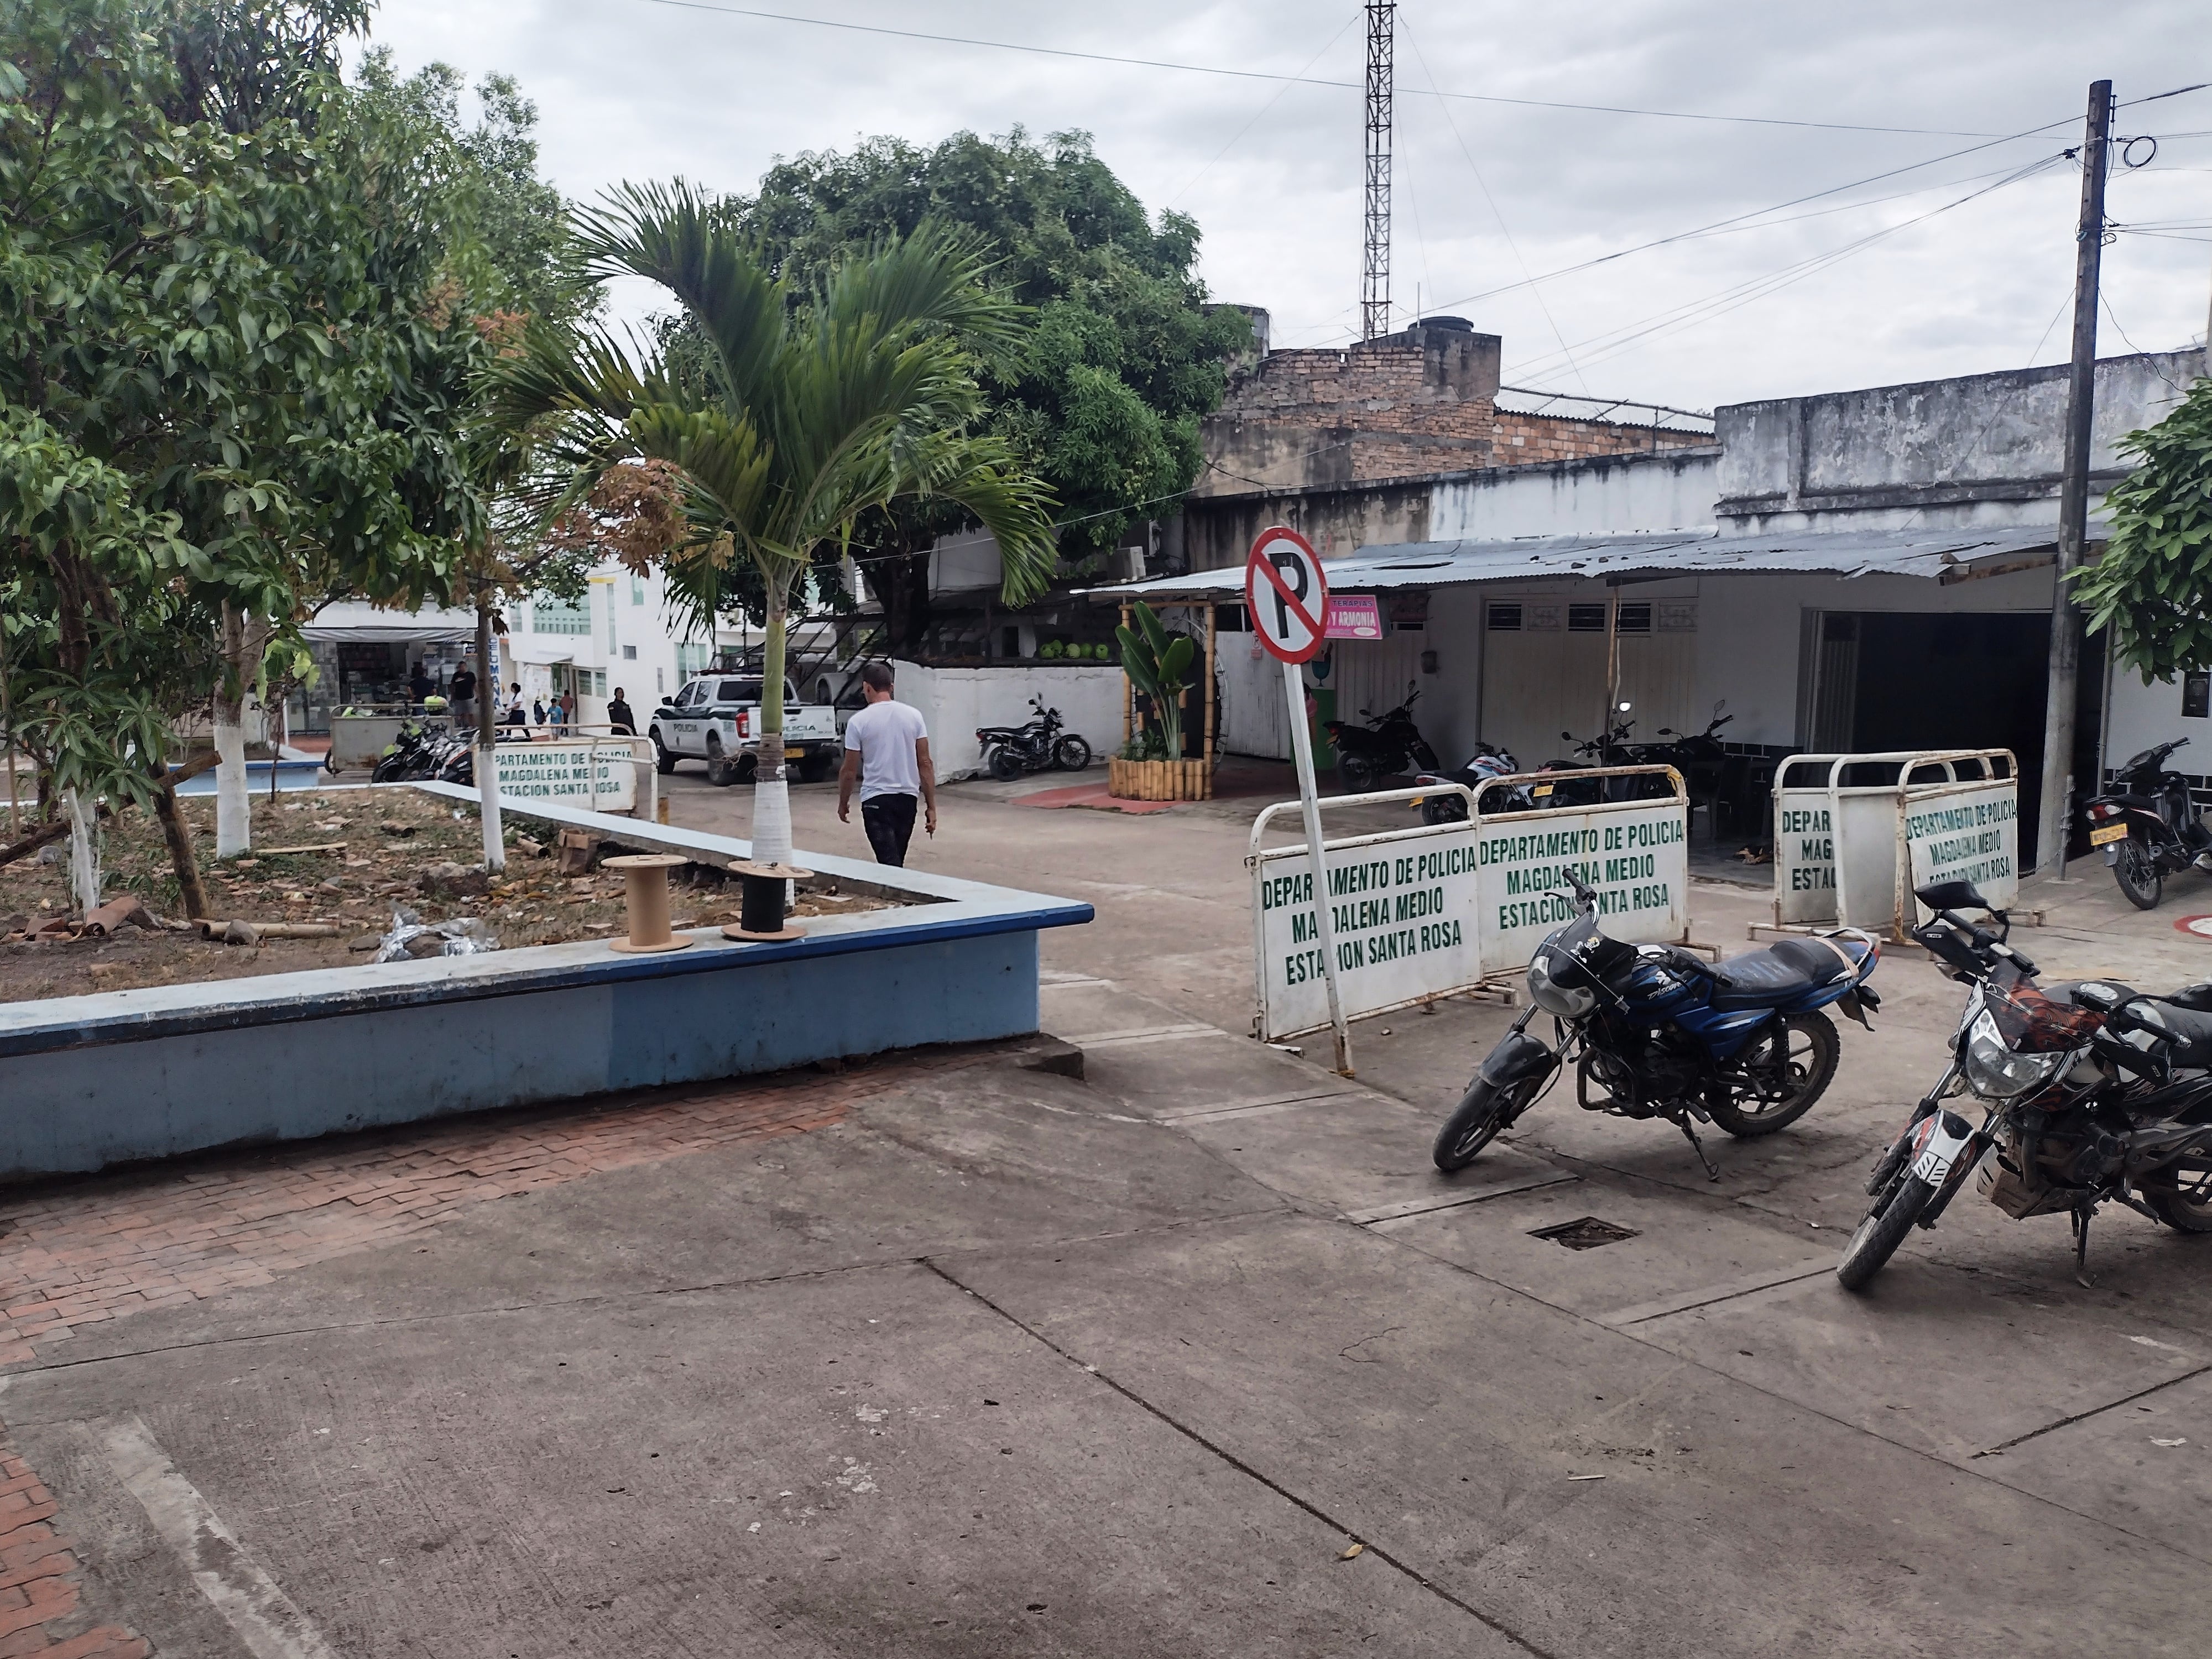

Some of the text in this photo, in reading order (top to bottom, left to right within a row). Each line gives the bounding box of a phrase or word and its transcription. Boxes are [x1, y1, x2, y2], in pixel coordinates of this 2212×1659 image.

[1331, 612, 1336, 626] Y
[1338, 612, 1376, 627] ARMONIA
[674, 723, 698, 732] POLICIA
[495, 753, 566, 766] PARTAMENTO
[571, 753, 585, 764] DE
[499, 766, 608, 782] MAGDALENA MEIO
[500, 785, 550, 796] STACION
[554, 783, 589, 795] SANTA
[1782, 811, 1830, 833] DEPAR
[1906, 799, 2017, 840] DEPARTAMENTO DE POLICIA
[1480, 820, 1683, 865] DEPARTAMENTO DE POLICIA
[1802, 839, 1831, 860] MAG
[1929, 830, 2001, 866] MAGDALENA MEDIO
[1262, 846, 1476, 910] DEPARMENTO DE POLICIA
[1506, 854, 1655, 895] MAGDALENA MEDIO
[1792, 867, 1836, 890] ESTAC
[1991, 856, 2010, 880] ROSA
[1292, 886, 1443, 943] MAALENA MEDIO
[1499, 896, 1576, 930] ESTACION
[1633, 883, 1669, 910] ROSA
[1285, 920, 1462, 985] ESTAION SANTA ROSA
